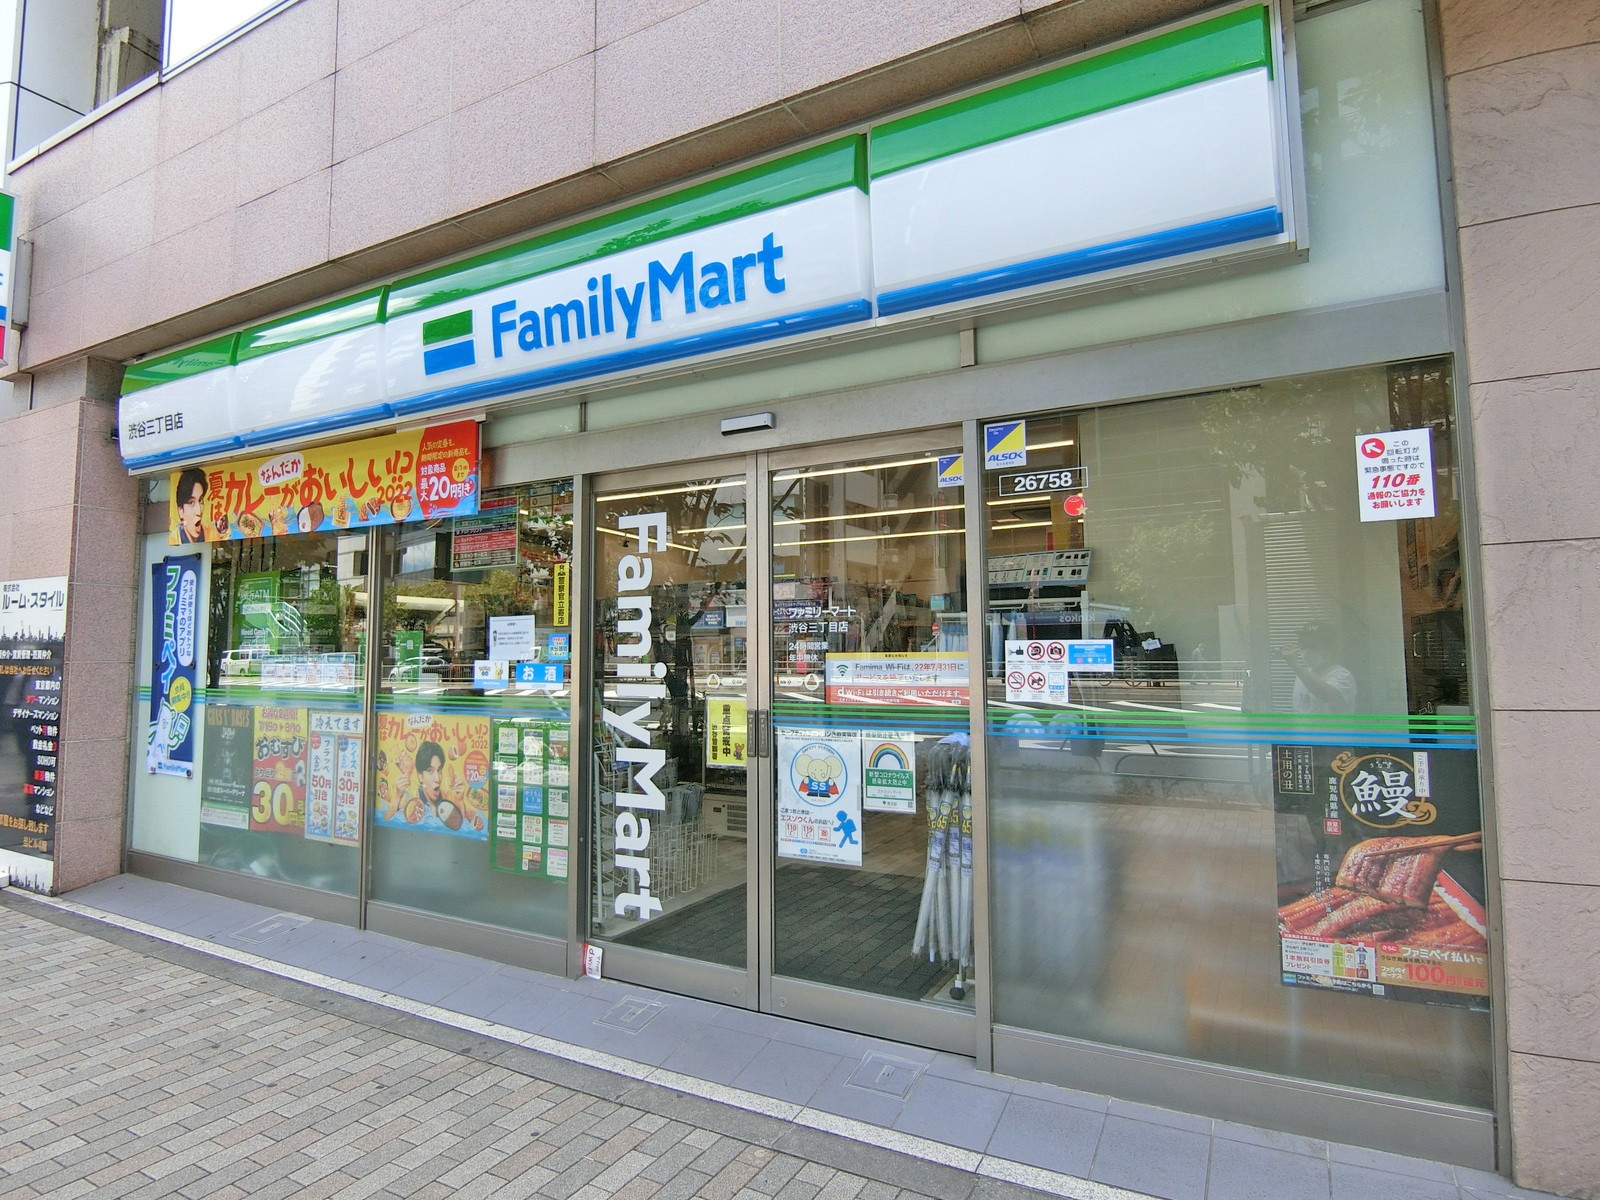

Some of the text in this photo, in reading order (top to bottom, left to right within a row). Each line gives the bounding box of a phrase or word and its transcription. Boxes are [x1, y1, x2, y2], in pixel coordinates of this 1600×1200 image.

[491, 232, 787, 360] FamilyMart
[128, 412, 184, 440] 渋谷三丁目店
[1393, 439, 1409, 448] この
[987, 450, 1024, 463] ALSOK
[260, 458, 303, 486] なんだか
[420, 462, 446, 476] 対象商品
[1364, 462, 1425, 474] 緊急事態ですので
[939, 475, 963, 483] ALSOK
[1013, 471, 1073, 492] 26758
[1371, 472, 1421, 489] 110番
[376, 480, 415, 506] 2022
[429, 476, 472, 501] 20円引き
[1367, 487, 1426, 500] 通報のご協力を
[205, 468, 228, 524] 夏は
[1372, 497, 1423, 509] お願いします
[3, 583, 20, 593] 株式会社
[2, 590, 65, 610] ルーム・スタイル
[178, 579, 189, 658] ファミマのアプリ
[788, 605, 857, 618] ファミリーマート
[162, 565, 181, 695] ファミペイ
[788, 620, 849, 634] 渋谷三丁目店
[788, 641, 829, 651] 24時間営業
[788, 652, 819, 662] 年中無休
[855, 663, 883, 671] Famima
[34, 680, 61, 691] 東京都内の
[12, 708, 60, 721] デザイナーズマンション
[406, 714, 433, 727] なんだか
[602, 511, 669, 922] FamilyMart
[315, 714, 361, 732] 冷えてます
[377, 714, 390, 743] 夏は
[256, 734, 306, 761] おむすび
[470, 739, 489, 750] 2022
[37, 755, 57, 768] SOHO可
[322, 739, 331, 773] フラッペ
[350, 741, 358, 770] アイス
[868, 771, 911, 780] 新型コロナウイルス
[1281, 749, 1295, 791] 土用の丑
[311, 774, 332, 790] 50円
[338, 777, 360, 793] 30円
[811, 781, 827, 791] SS
[871, 778, 908, 787] 感染拡大防止中
[313, 789, 328, 802] 引き
[341, 792, 356, 806] 引き
[1328, 776, 1339, 819] 鹿児島県産
[1350, 769, 1418, 820] 鰻
[35, 803, 54, 816] などなど
[252, 780, 295, 826] 30
[787, 824, 797, 832] 110
[961, 819, 972, 834] 65
[1382, 945, 1398, 953] さらに
[1401, 946, 1485, 966] ファミペイ払いで
[1284, 954, 1331, 966] 1本無料引換券
[1285, 962, 1312, 971] プレゼント
[1380, 966, 1406, 975] ファミペイ
[1380, 972, 1403, 980] ボーナス
